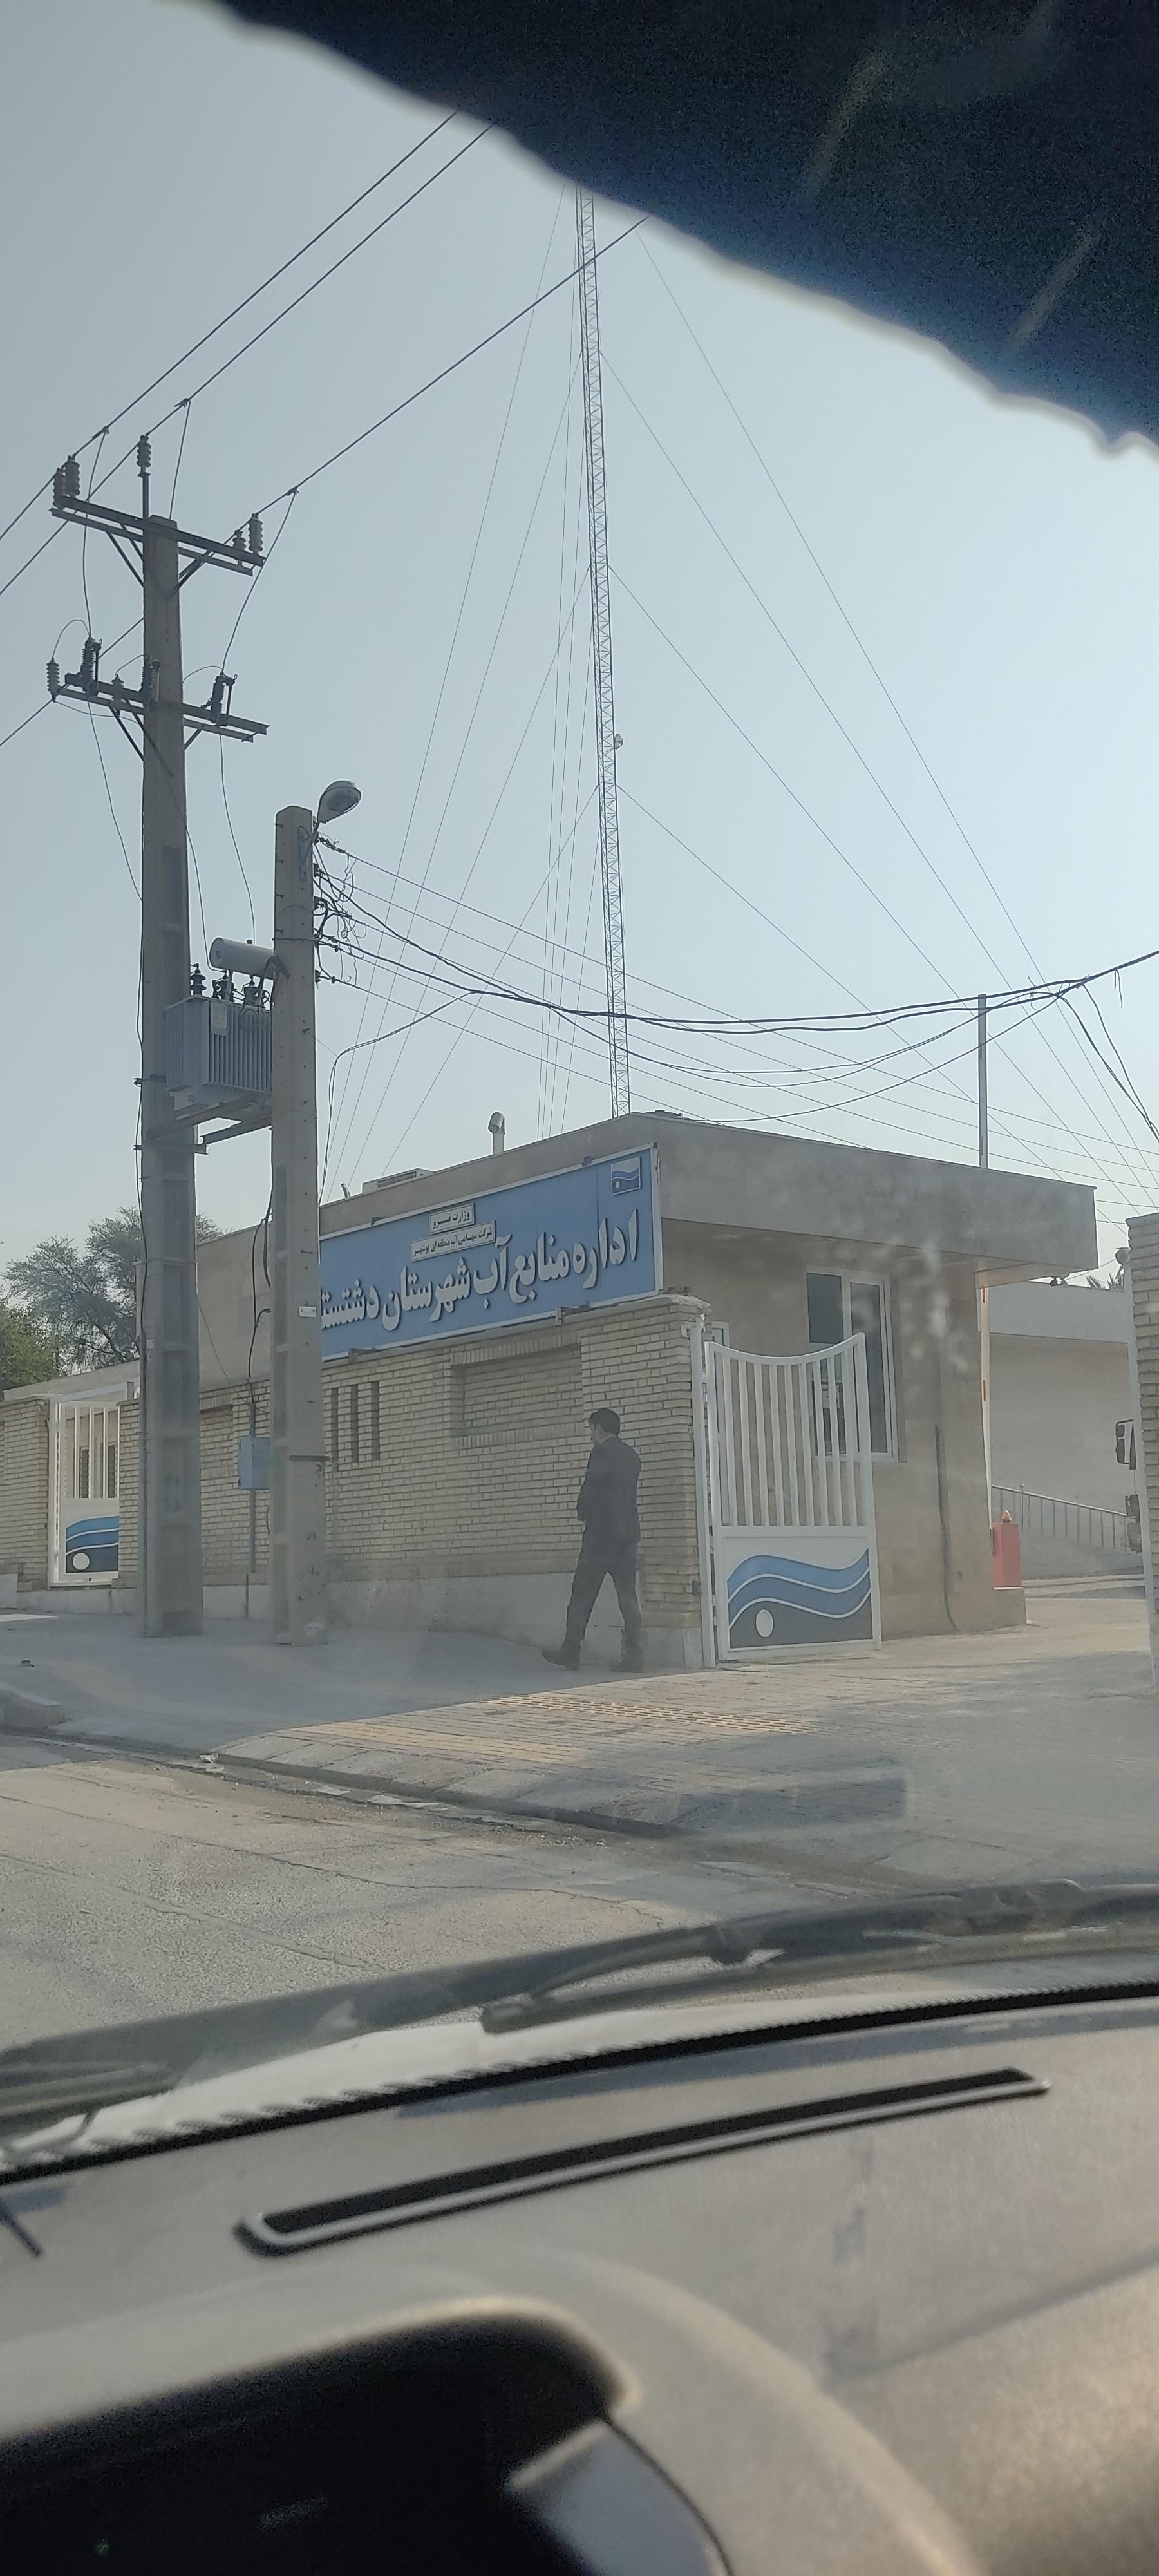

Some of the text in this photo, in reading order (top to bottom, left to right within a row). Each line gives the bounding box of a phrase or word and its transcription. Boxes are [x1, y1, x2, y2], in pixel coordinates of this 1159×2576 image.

[321, 1209, 638, 1331] اداره منابع آب شهرستان دشتست
